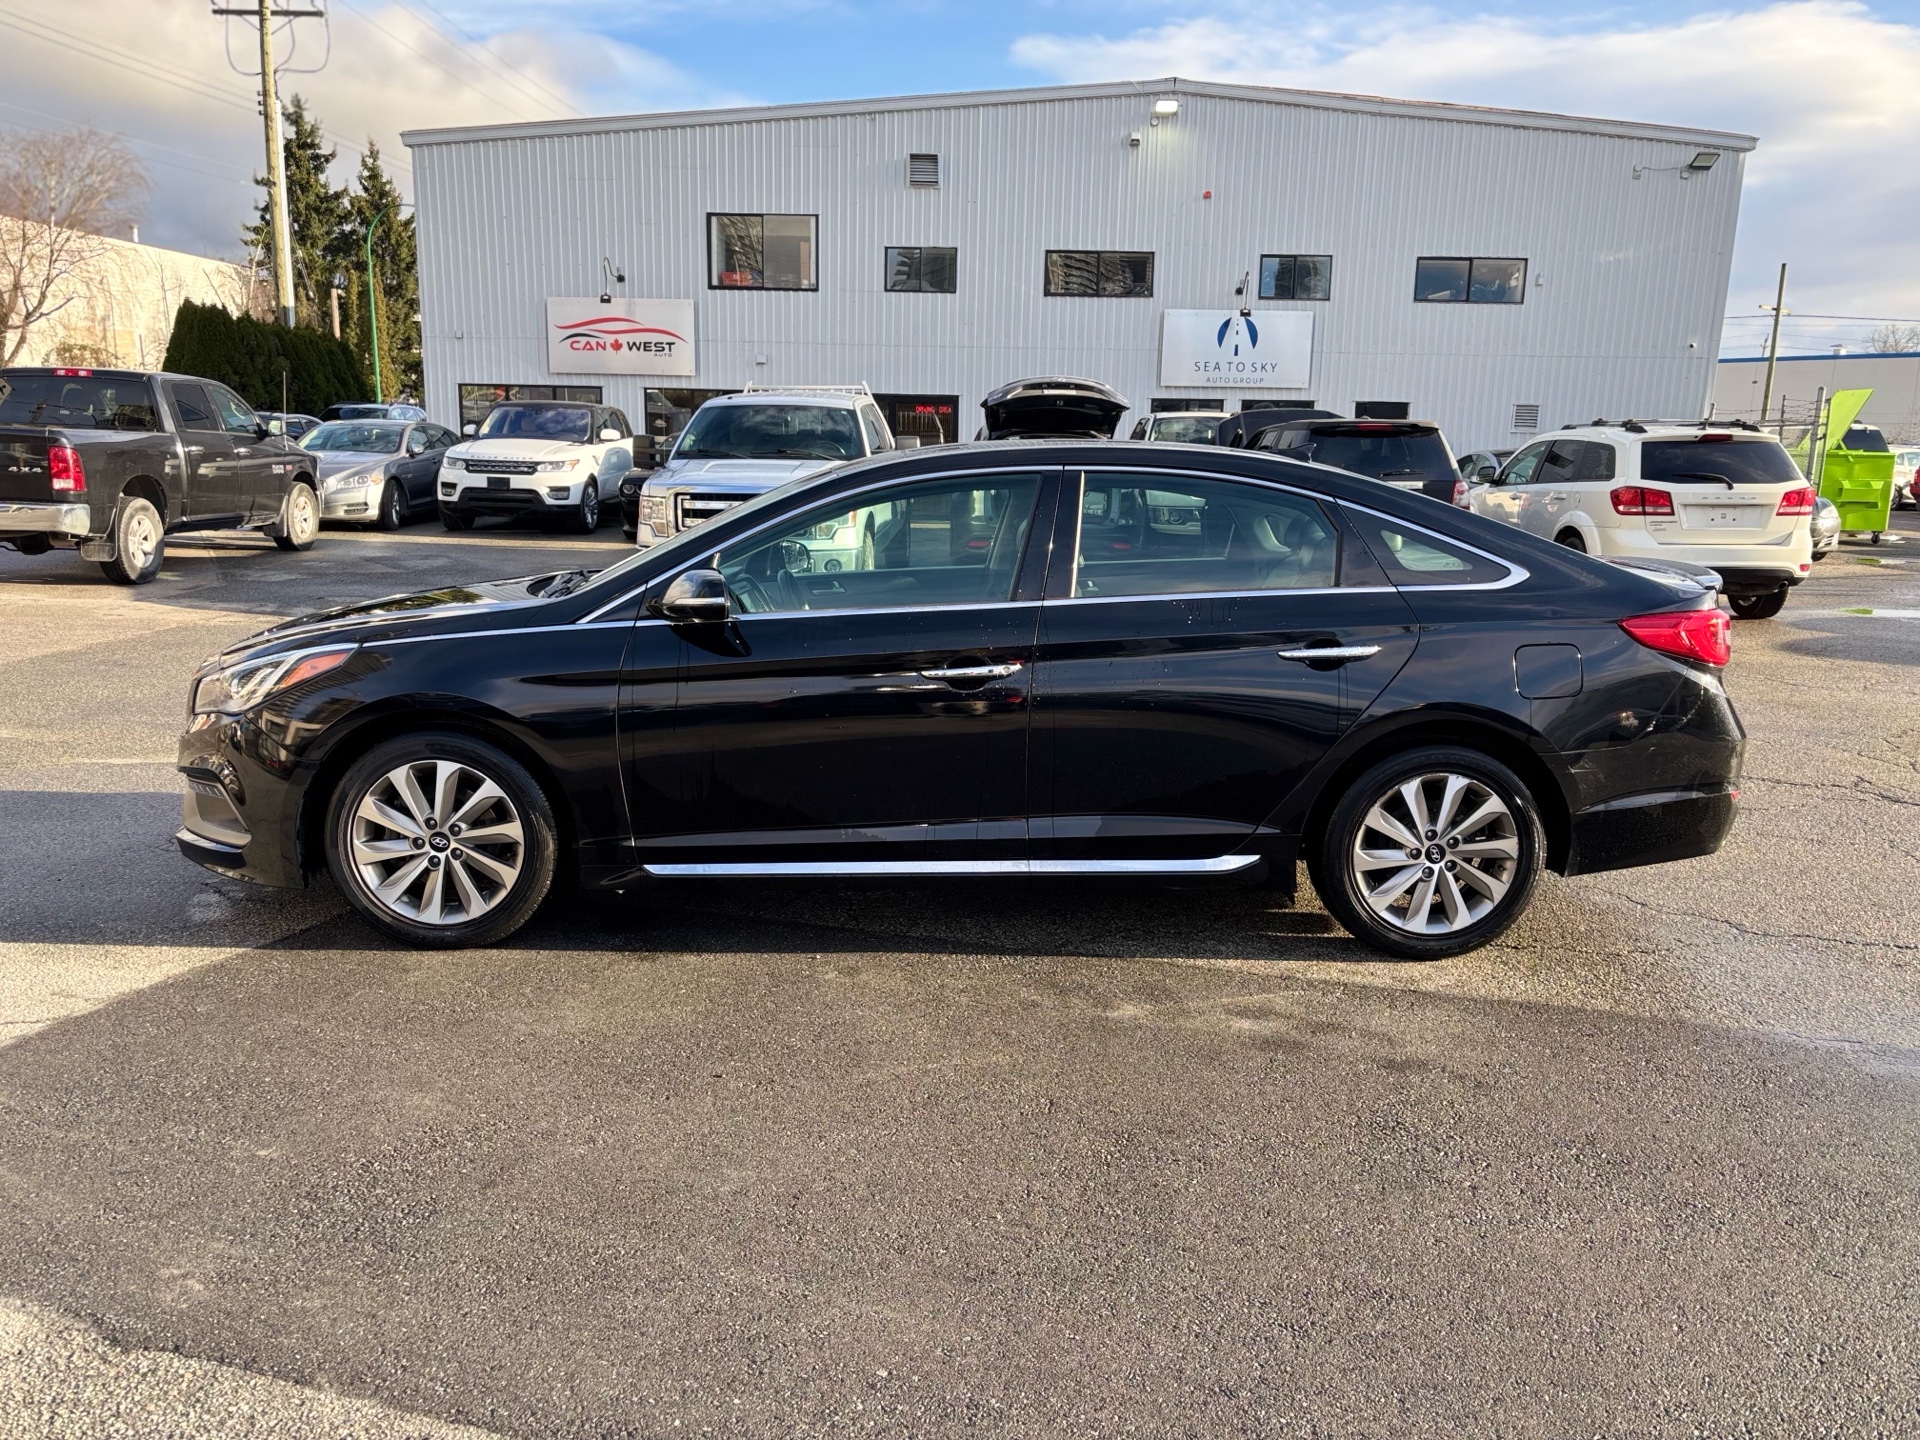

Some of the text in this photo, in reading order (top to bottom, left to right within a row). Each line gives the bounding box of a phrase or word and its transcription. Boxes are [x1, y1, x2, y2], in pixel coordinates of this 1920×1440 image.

[569, 340, 676, 352] CAN WEST
[1194, 361, 1278, 373] SEA TO SKY
